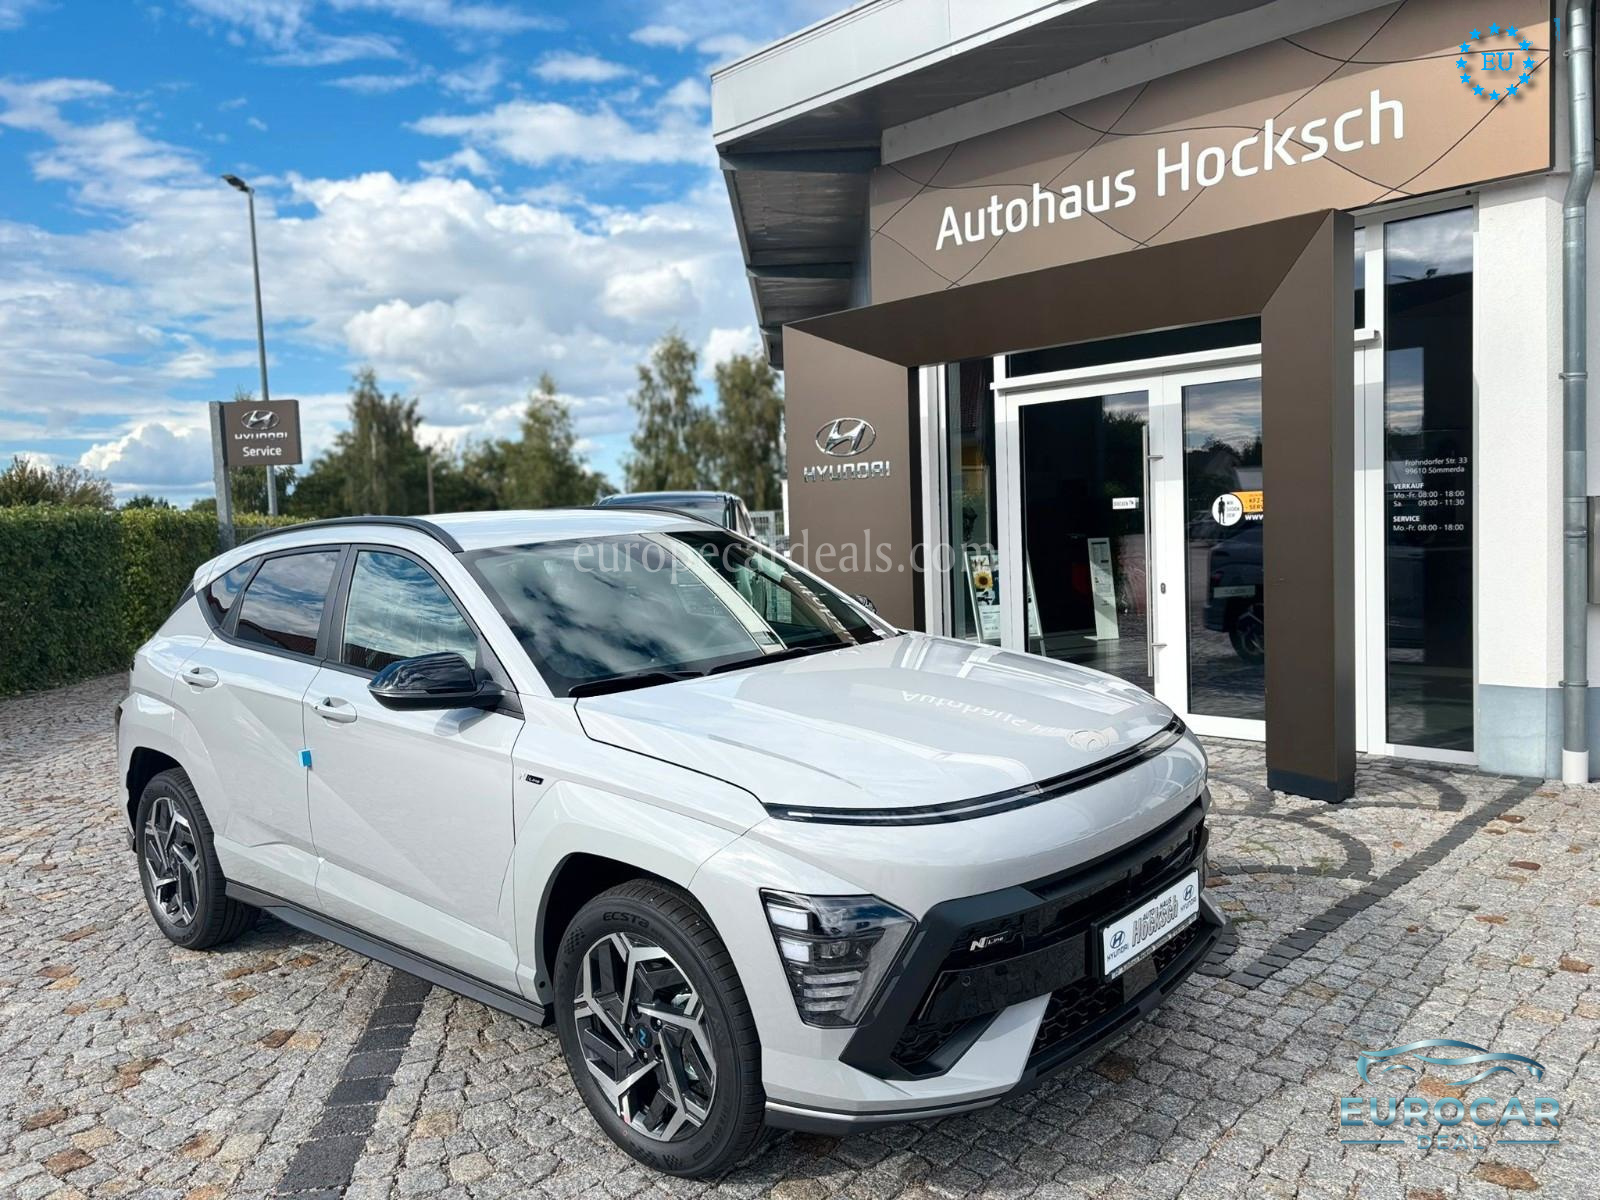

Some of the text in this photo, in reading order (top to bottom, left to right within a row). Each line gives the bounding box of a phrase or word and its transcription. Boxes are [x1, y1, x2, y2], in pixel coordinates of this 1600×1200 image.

[935, 88, 1405, 251] Autohaus Hocksch
[242, 445, 282, 457] Service
[1458, 456, 1468, 464] 33
[803, 460, 891, 483] HYUNDAI
[1393, 482, 1424, 490] VERKAUF
[1444, 523, 1465, 531] 18:00
[1180, 897, 1197, 912] HYUNDAI
[1107, 943, 1129, 961] HYUNDAI
